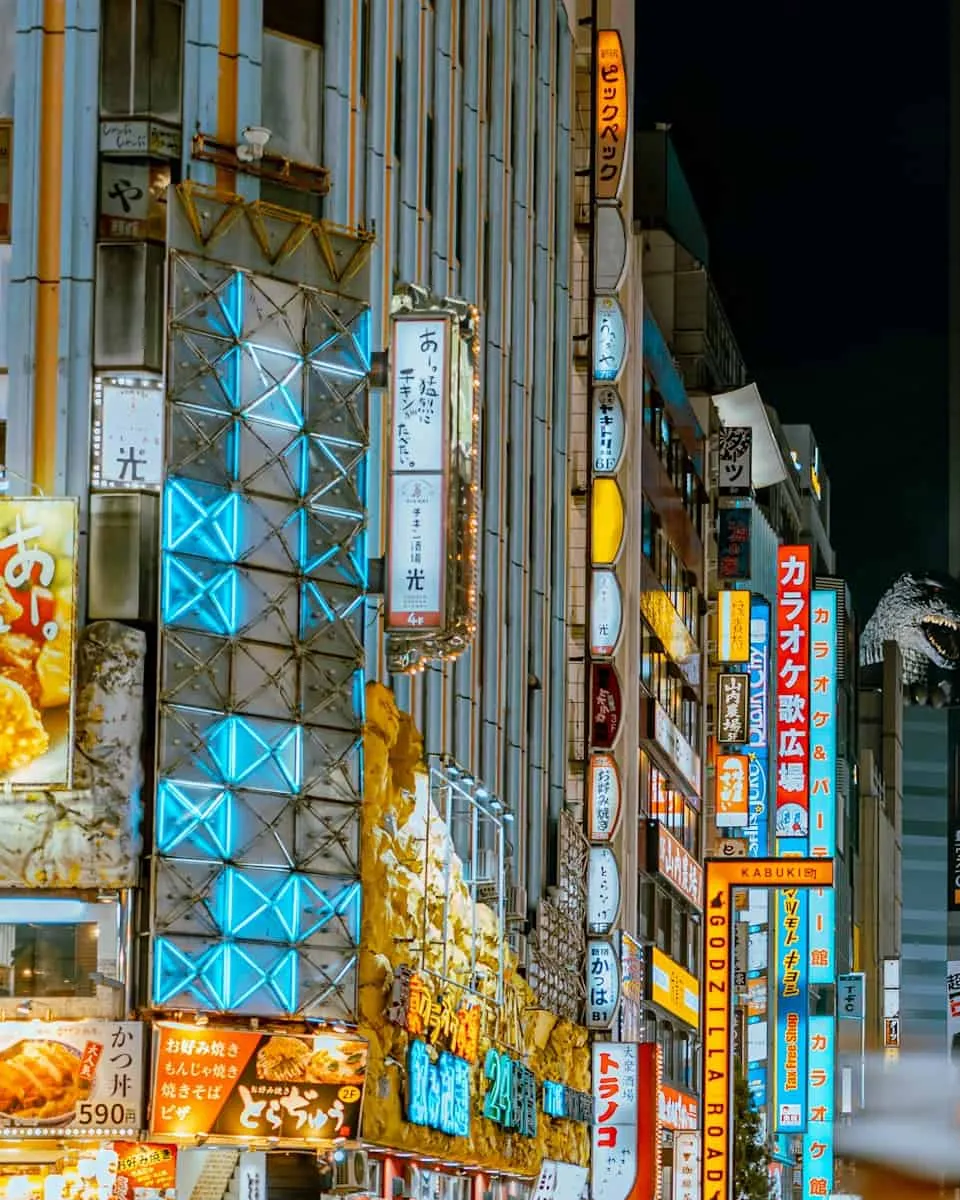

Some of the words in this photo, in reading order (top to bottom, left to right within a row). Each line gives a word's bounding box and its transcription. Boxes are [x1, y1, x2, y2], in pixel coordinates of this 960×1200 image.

[116, 446, 148, 481] 光
[406, 568, 426, 591] 光
[777, 554, 806, 792] カラオケ歌広場
[708, 915, 726, 1082] GODZILLA
[109, 1025, 134, 1099] かつ丼
[165, 1037, 240, 1057] お好み焼き
[164, 1060, 240, 1080] もんじゃ焼き
[160, 1082, 223, 1100] 焼きそば
[341, 1089, 358, 1099] 2F
[597, 1052, 620, 1149] トラノコ
[78, 1103, 137, 1125] 590円
[808, 1034, 828, 1197] カラオケ館
[706, 1103, 724, 1182] ROAD
